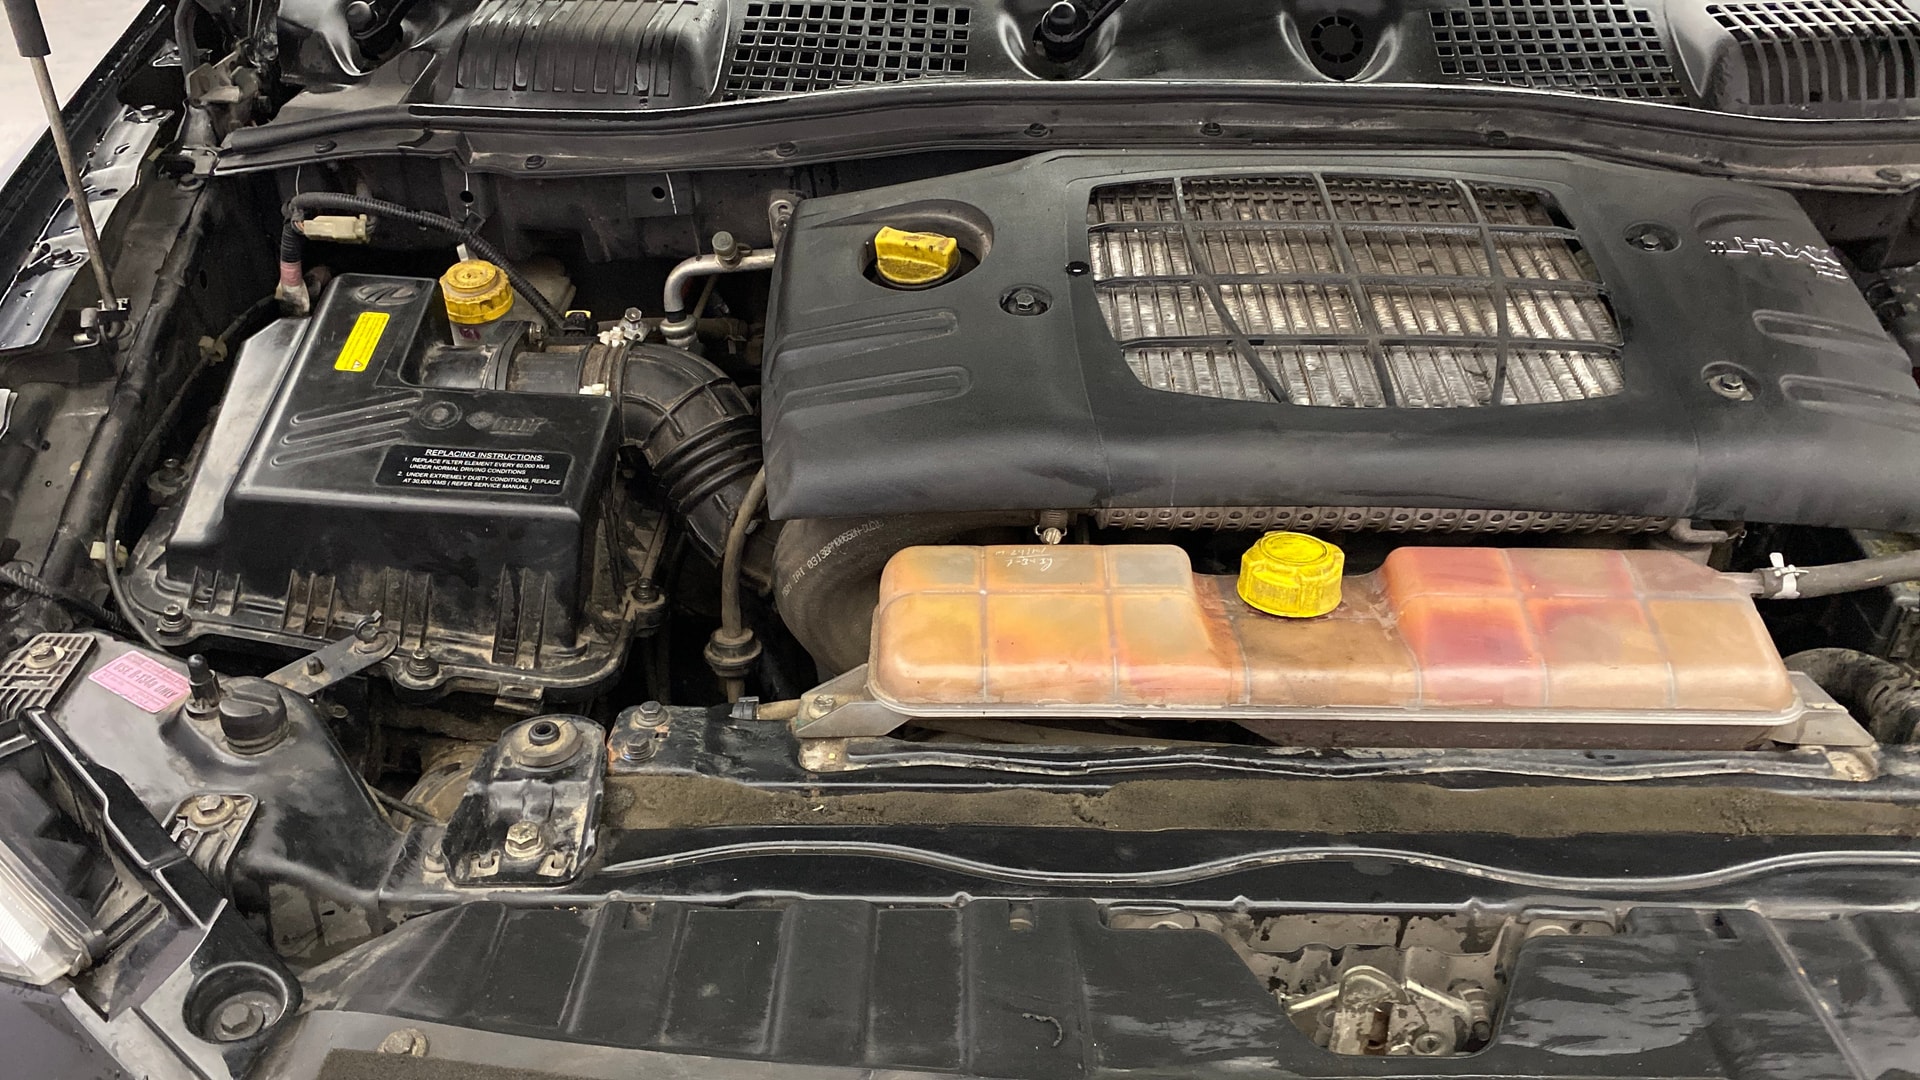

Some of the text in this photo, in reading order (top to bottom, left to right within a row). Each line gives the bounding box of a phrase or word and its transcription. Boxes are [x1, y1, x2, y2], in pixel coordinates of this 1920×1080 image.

[424, 448, 476, 458] REPLACING
[412, 457, 440, 465] REPLACE
[531, 478, 561, 486] REPLACE
